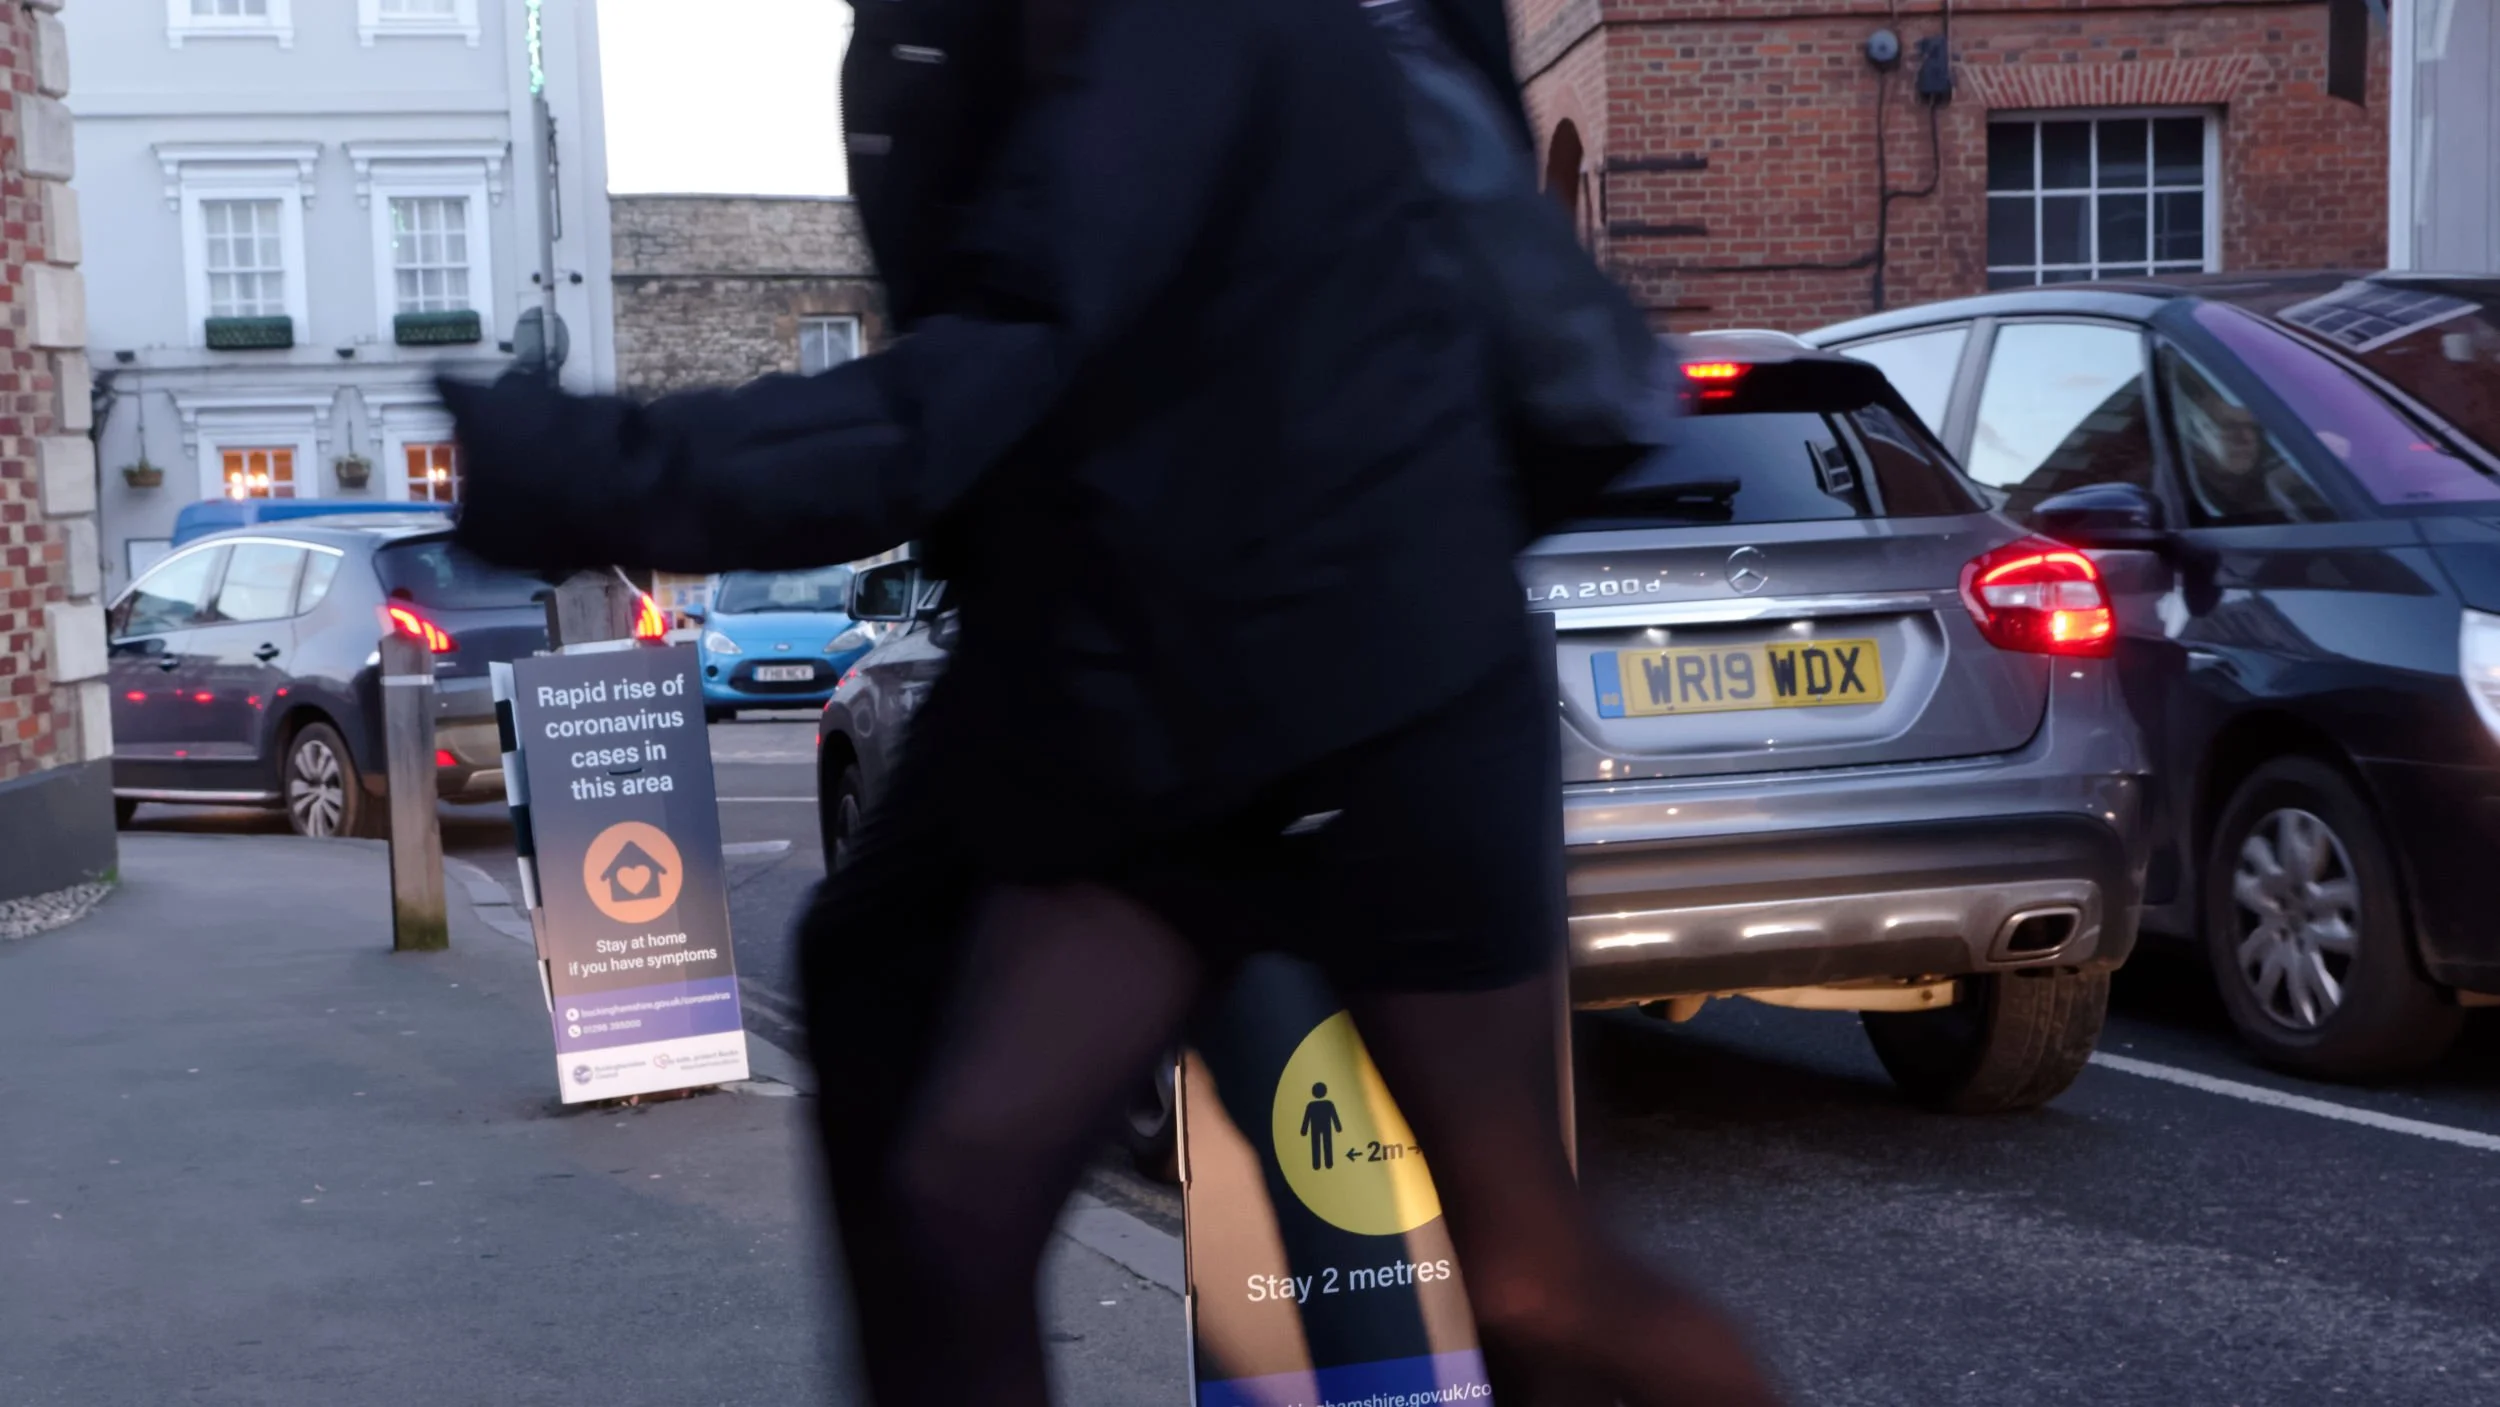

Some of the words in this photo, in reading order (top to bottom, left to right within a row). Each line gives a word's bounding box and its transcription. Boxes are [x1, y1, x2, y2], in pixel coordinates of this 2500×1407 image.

[537, 680, 607, 710] Rapid
[613, 678, 657, 701] rise
[661, 673, 685, 697] of
[1641, 652, 1757, 706] WR19
[1768, 646, 1866, 699] WDX
[545, 709, 684, 740] coronavirus
[570, 745, 640, 769] cases
[645, 741, 667, 763] in
[570, 778, 616, 801] this
[622, 774, 674, 796] area
[596, 938, 628, 955] Stay
[631, 934, 646, 949] at
[648, 931, 687, 947] home
[569, 961, 579, 977] if
[581, 961, 608, 979] you
[611, 955, 644, 972] have
[647, 947, 718, 970] symptoms
[1366, 1142, 1403, 1163] 2m
[1247, 1273, 1313, 1306] Stay
[1322, 1266, 1341, 1294] 2
[1349, 1257, 1452, 1292] metres
